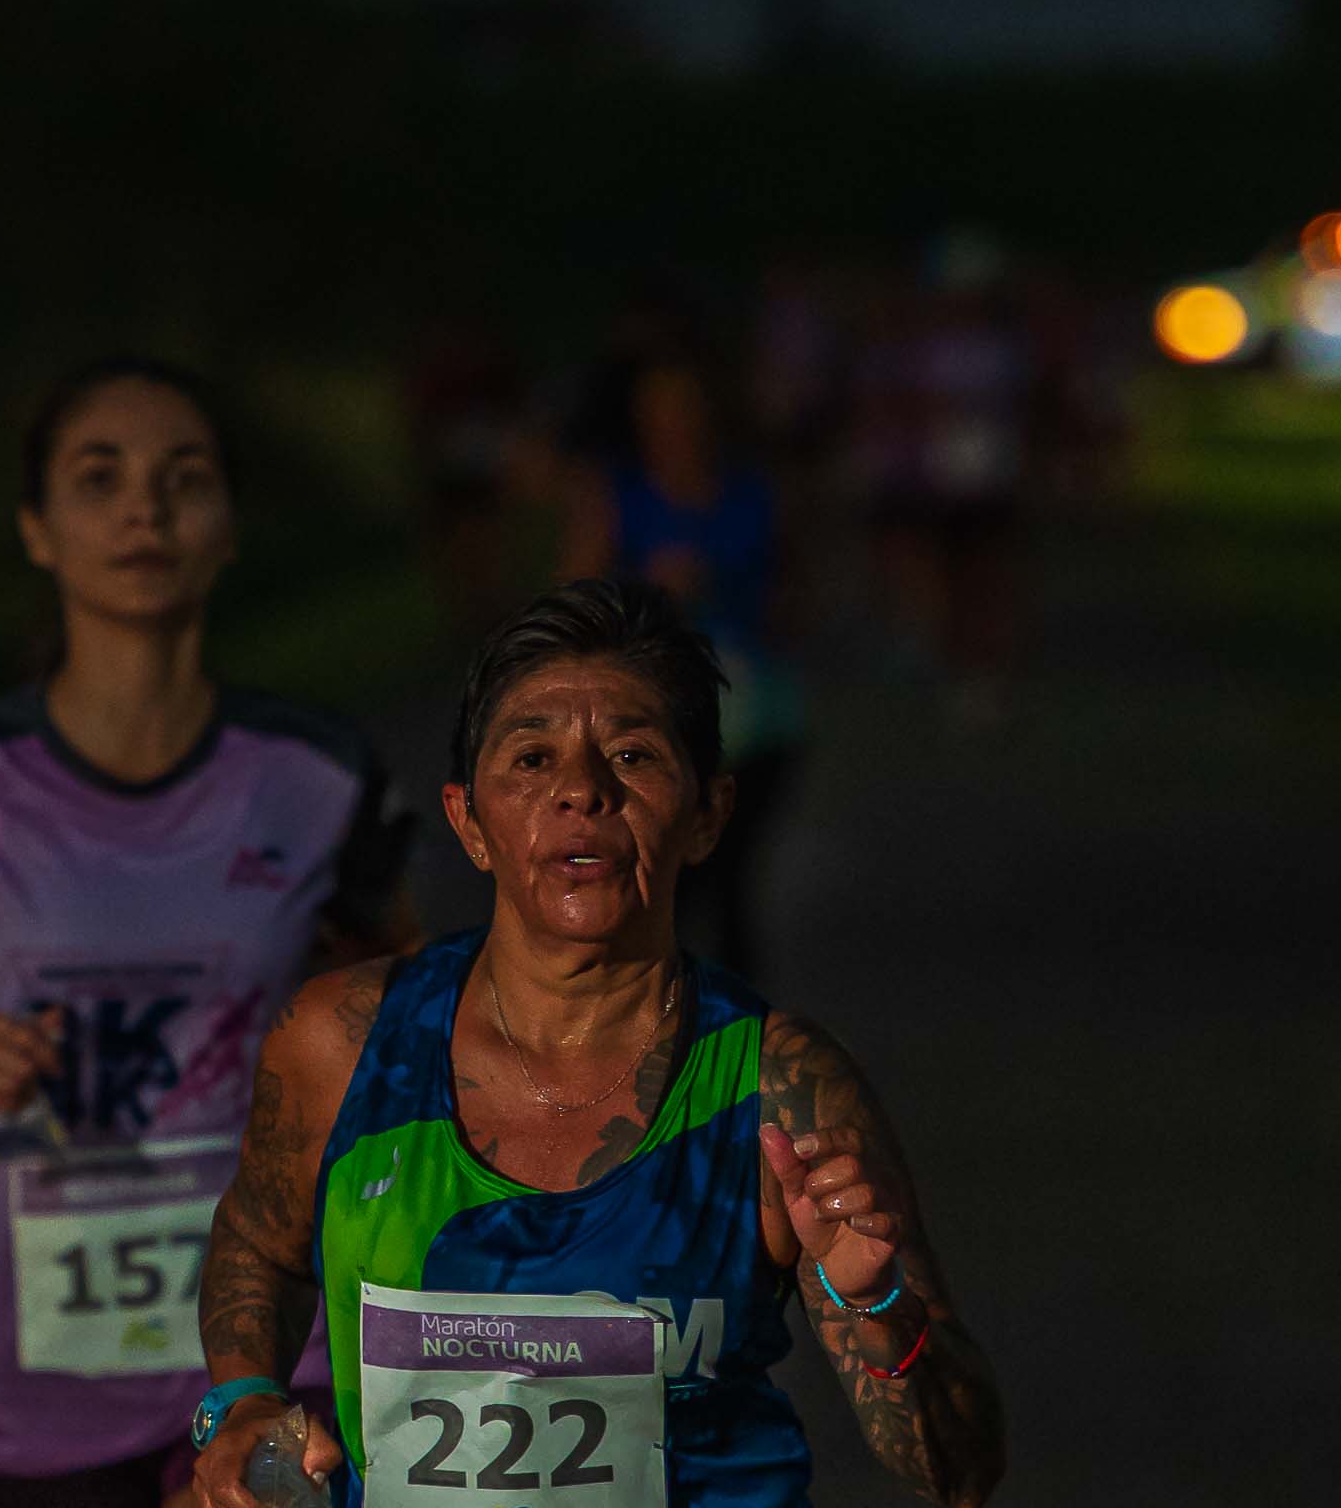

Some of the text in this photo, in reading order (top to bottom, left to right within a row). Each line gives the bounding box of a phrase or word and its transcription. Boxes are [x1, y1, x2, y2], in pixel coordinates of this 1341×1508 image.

[421, 1314, 515, 1337] Maratón
[422, 1337, 583, 1364] NOCTURNA
[407, 1398, 615, 1490] 222
